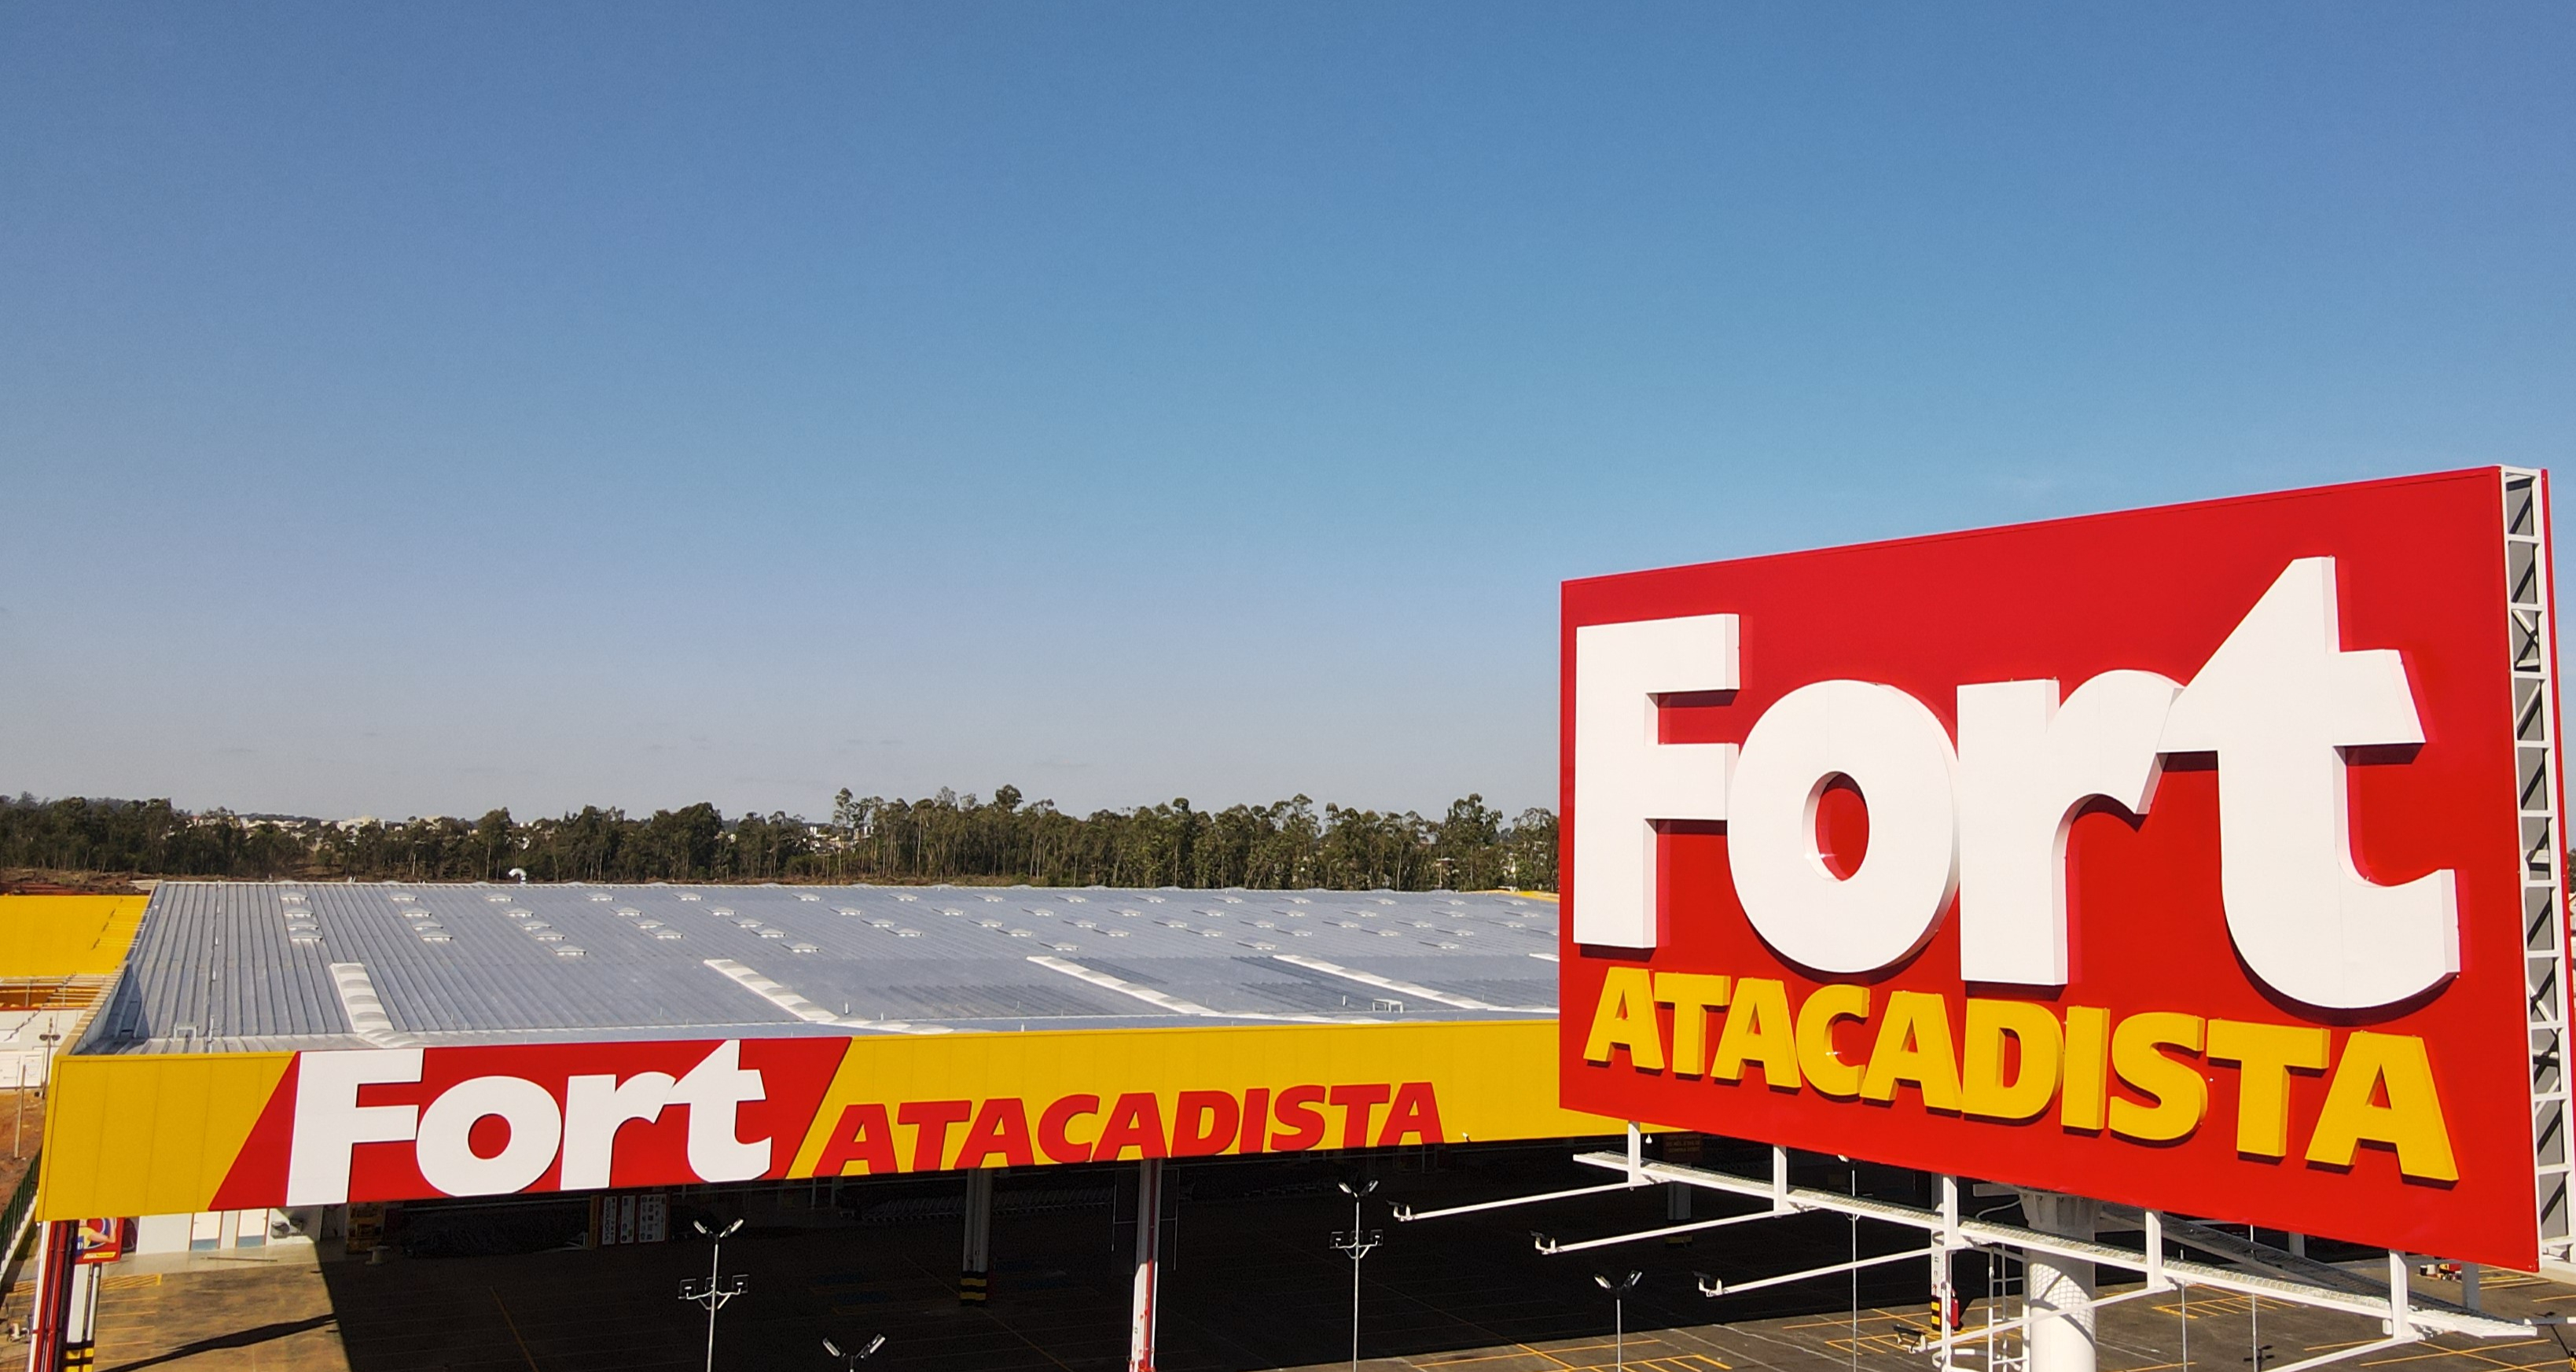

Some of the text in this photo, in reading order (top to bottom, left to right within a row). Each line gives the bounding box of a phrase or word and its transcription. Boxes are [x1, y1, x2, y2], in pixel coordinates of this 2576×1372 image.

[1574, 557, 2460, 1009] Fort
[286, 1039, 772, 1207] Fort
[813, 1082, 1445, 1178] ATACADISTA
[1585, 968, 2459, 1182] ATACADISTA
